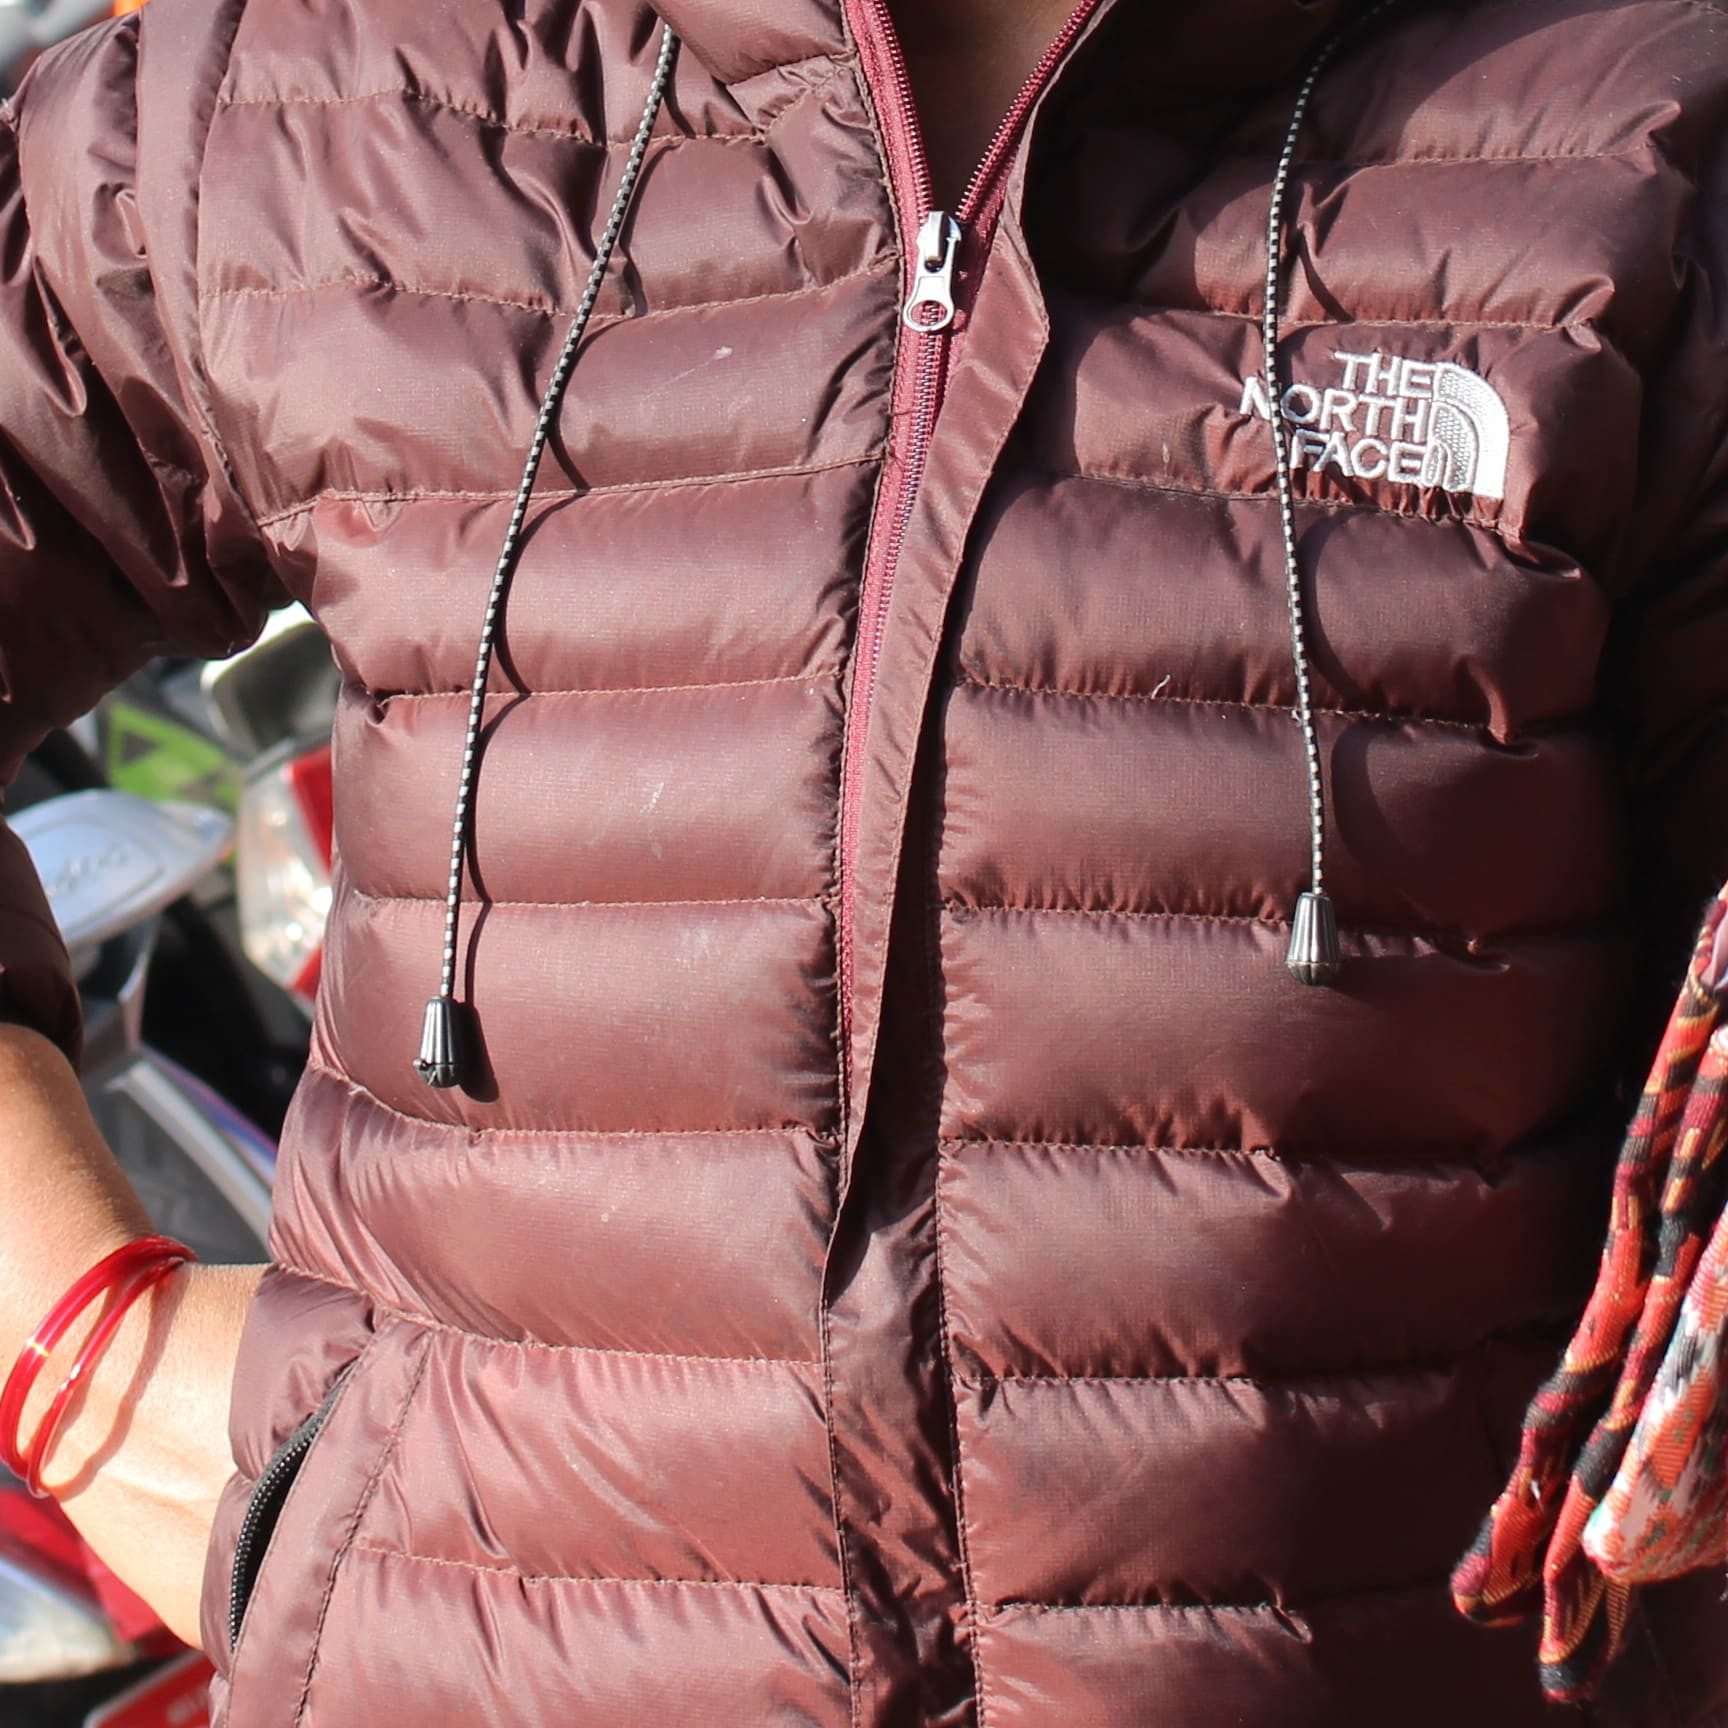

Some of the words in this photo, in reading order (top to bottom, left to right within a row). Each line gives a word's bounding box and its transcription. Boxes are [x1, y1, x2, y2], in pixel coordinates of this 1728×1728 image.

[1333, 349, 1437, 397] THE
[1239, 376, 1429, 443] NORTH
[1289, 428, 1428, 485] FACE
